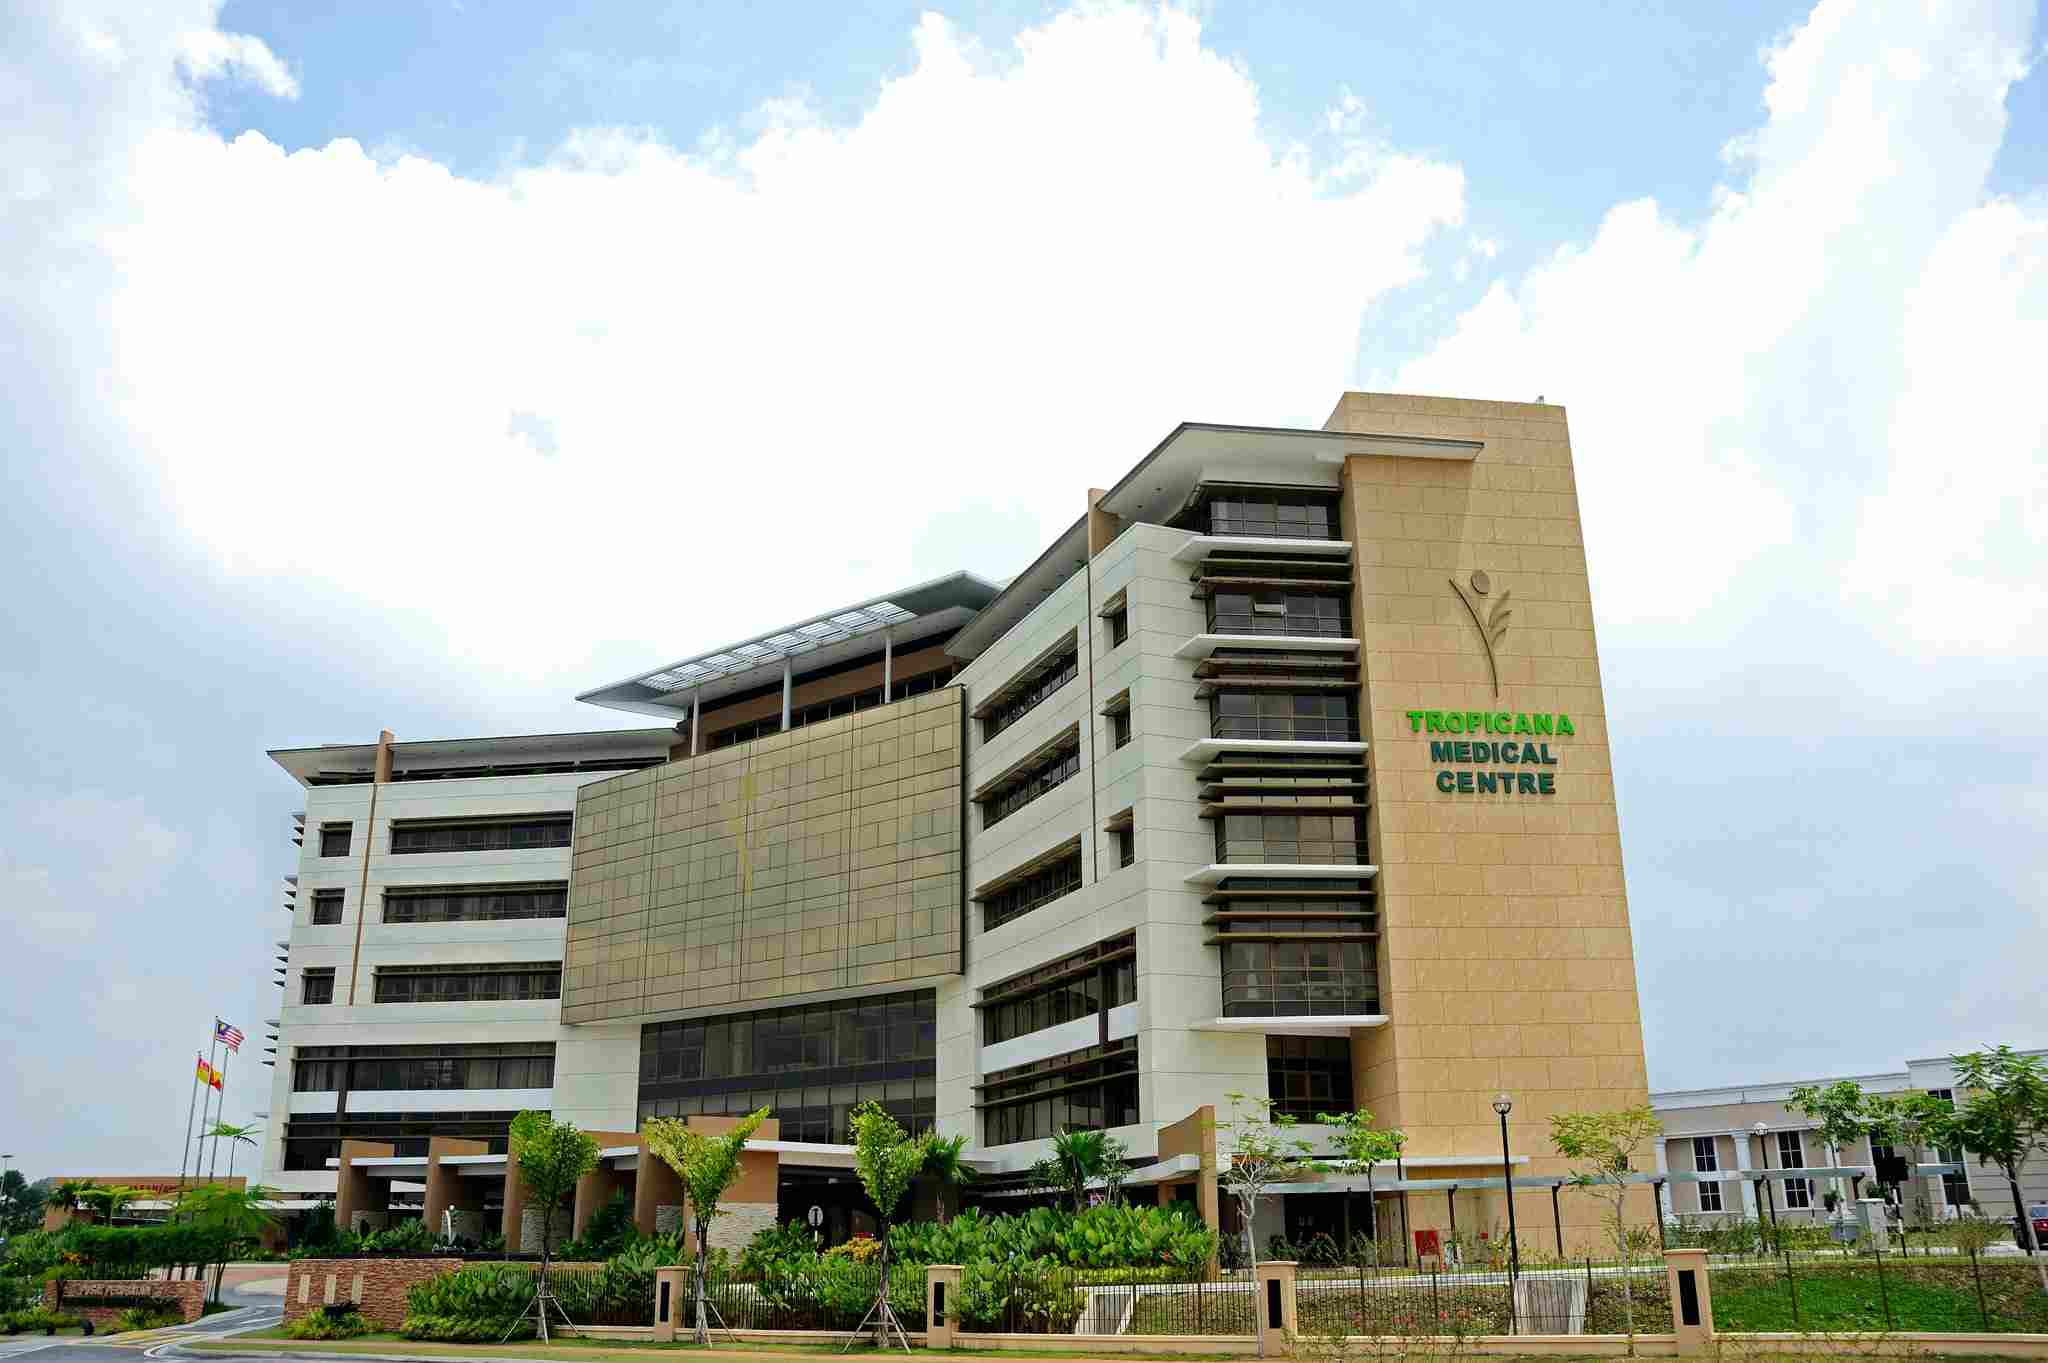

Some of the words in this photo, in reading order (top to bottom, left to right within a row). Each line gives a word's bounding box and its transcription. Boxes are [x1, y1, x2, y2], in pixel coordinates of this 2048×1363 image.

[1406, 711, 1575, 736] TROPICANA
[1430, 741, 1557, 764] MEDICAL
[1436, 770, 1556, 794] CENTRE
